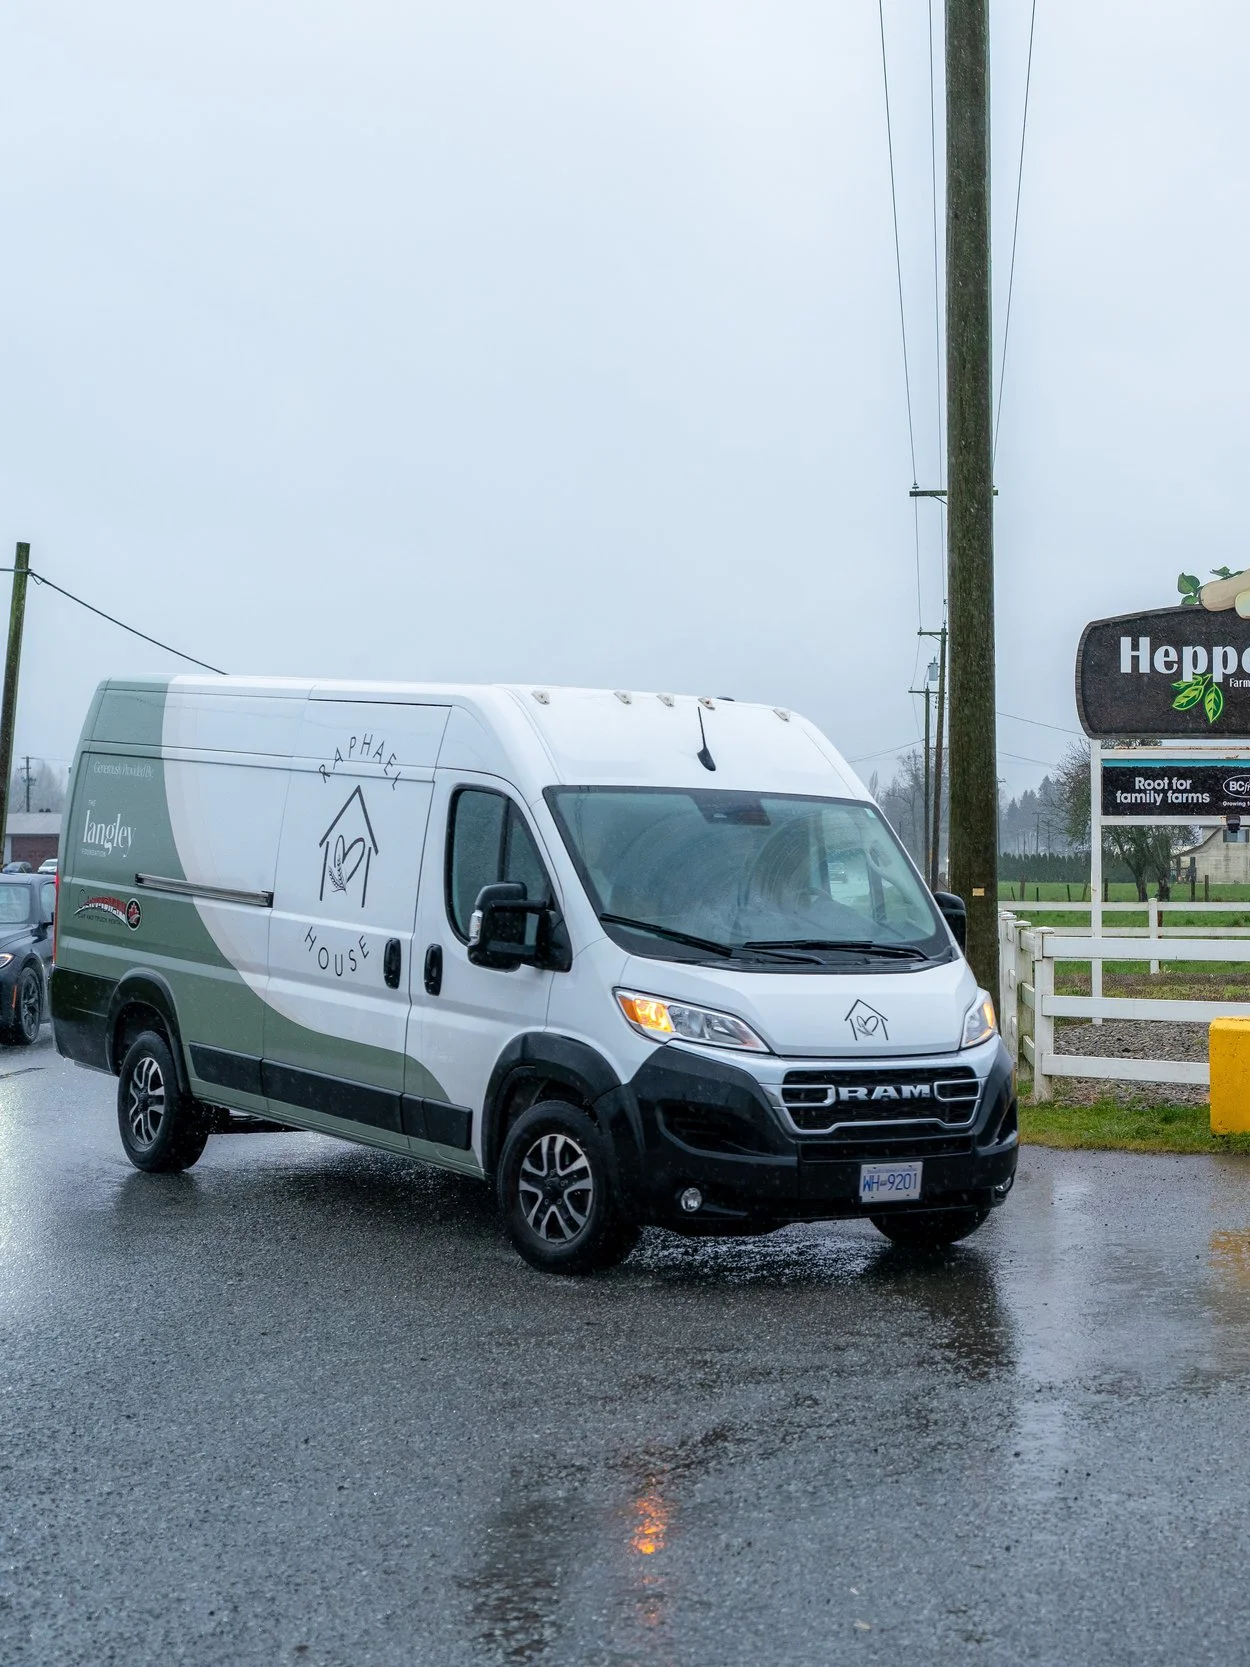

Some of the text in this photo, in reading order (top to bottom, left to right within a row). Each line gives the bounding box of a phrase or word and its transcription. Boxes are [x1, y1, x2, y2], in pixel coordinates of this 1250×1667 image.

[1229, 677, 1250, 688] Farm
[318, 733, 401, 790] RAPHAEL
[1134, 776, 1193, 790] Root for
[1115, 790, 1211, 806] family farms
[1222, 800, 1247, 808] Growing
[83, 809, 137, 858] langley
[304, 926, 369, 977] HOUSE
[838, 1084, 931, 1101] RAM
